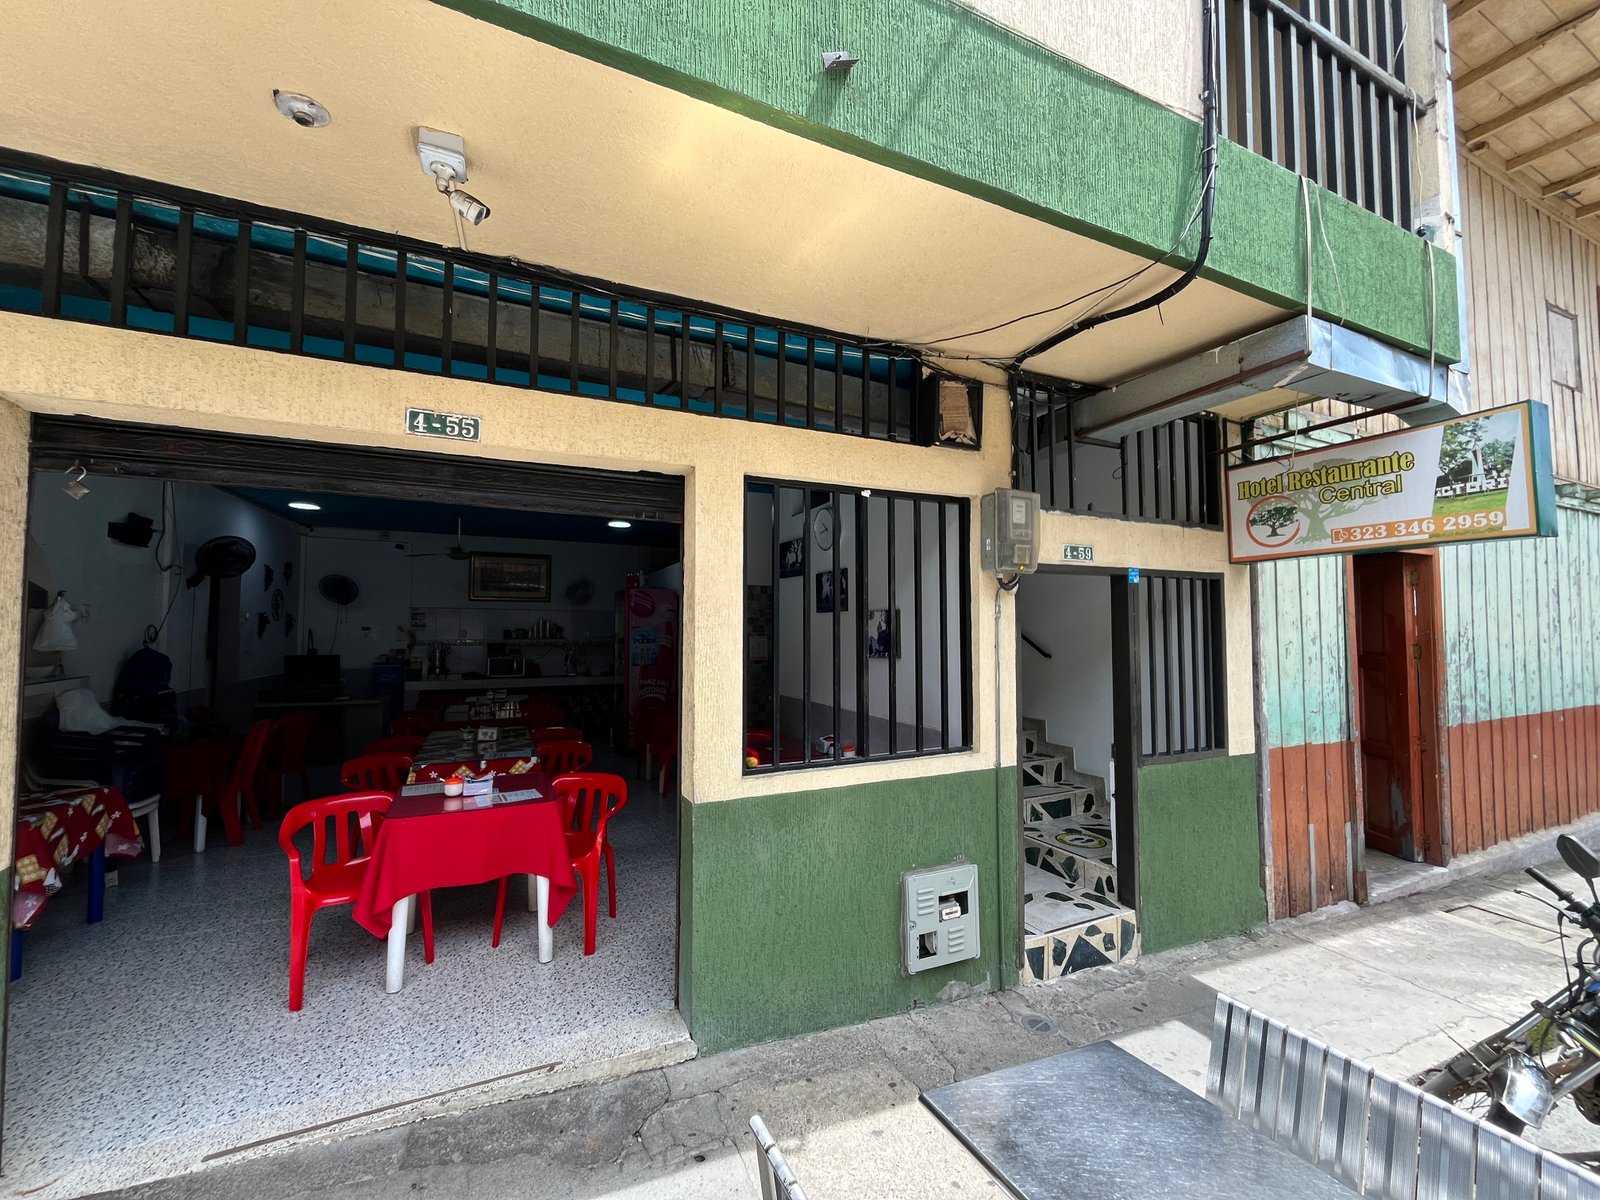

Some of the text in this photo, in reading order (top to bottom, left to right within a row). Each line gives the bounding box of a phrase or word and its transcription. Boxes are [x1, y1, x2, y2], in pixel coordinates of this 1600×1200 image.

[413, 413, 475, 438] 4-55
[1237, 450, 1415, 500] Hotel Restaurante
[1318, 474, 1403, 504] Central
[1350, 511, 1504, 541] 323 346 2959
[1066, 546, 1091, 560] 4-59
